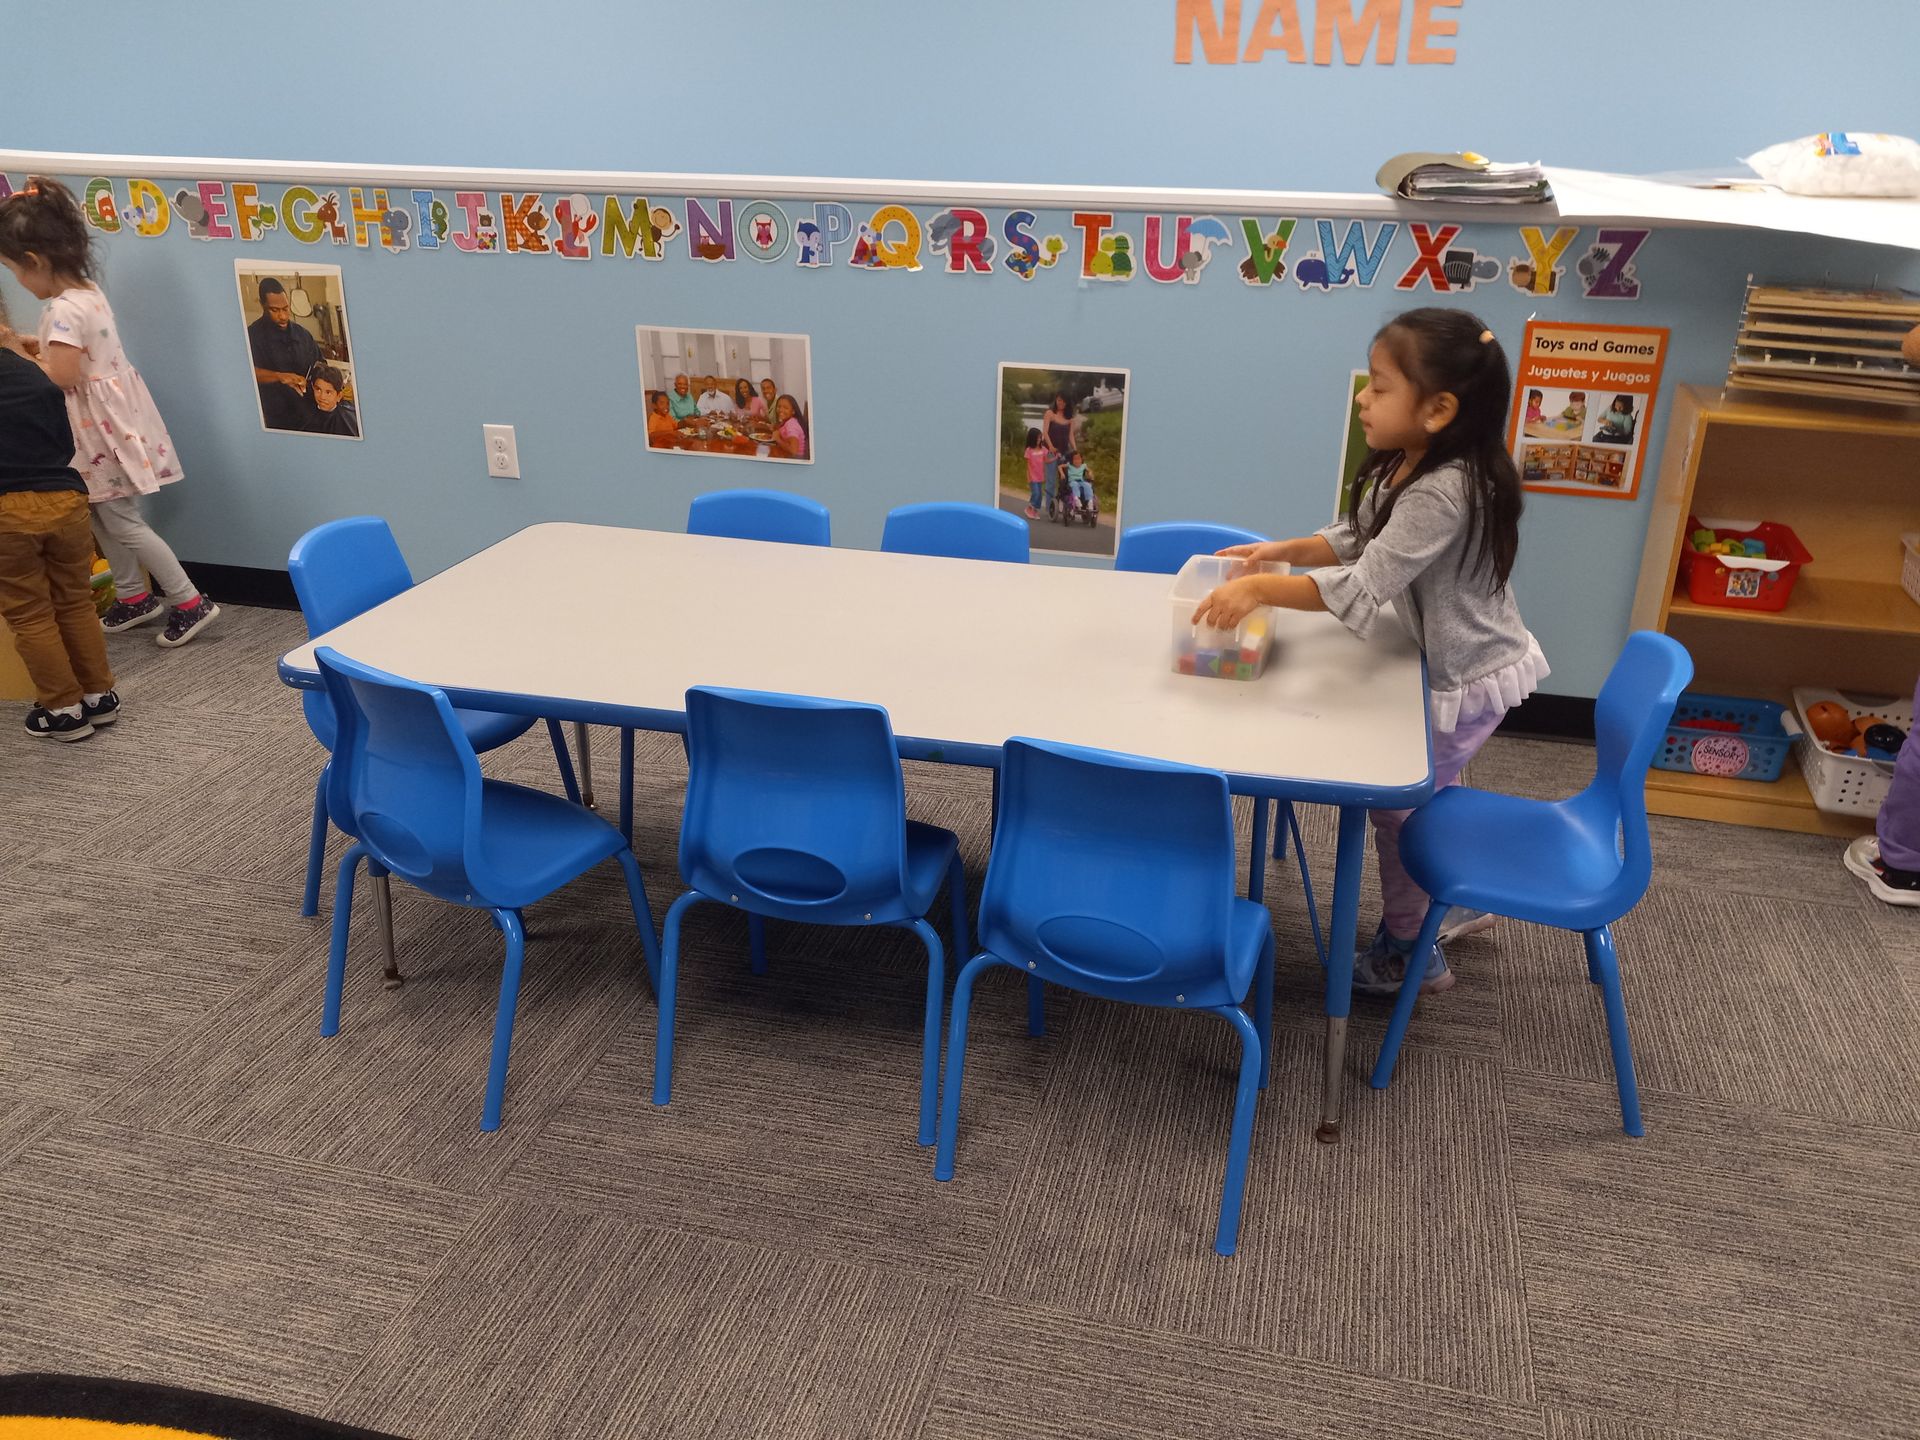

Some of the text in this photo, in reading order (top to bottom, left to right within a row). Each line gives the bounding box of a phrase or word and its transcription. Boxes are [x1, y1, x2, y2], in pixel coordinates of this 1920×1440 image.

[1174, 0, 1462, 66] NAME
[86, 178, 120, 233] C
[129, 180, 169, 236] D
[198, 182, 234, 238] E
[232, 184, 260, 240] F
[282, 187, 324, 243] G
[349, 188, 393, 247] H
[412, 190, 437, 248] I
[455, 193, 486, 251] J
[501, 195, 549, 253] K
[557, 199, 590, 258] L
[603, 198, 656, 257] M
[688, 199, 735, 259] N
[738, 201, 790, 262] O
[815, 203, 853, 265] P
[868, 206, 922, 269] Q
[950, 209, 992, 272] R
[1005, 211, 1037, 279] S
[1074, 213, 1112, 277] T
[1145, 217, 1193, 282] U
[1241, 218, 1297, 284] V
[1316, 220, 1398, 286] W
[1398, 224, 1461, 291] X
[1521, 227, 1579, 294] Y
[1587, 229, 1650, 298] Z
[1535, 337, 1655, 355] Toys and Games
[1527, 365, 1651, 385] Juguetes y Juegos
[1703, 744, 1741, 761] SENSORY
